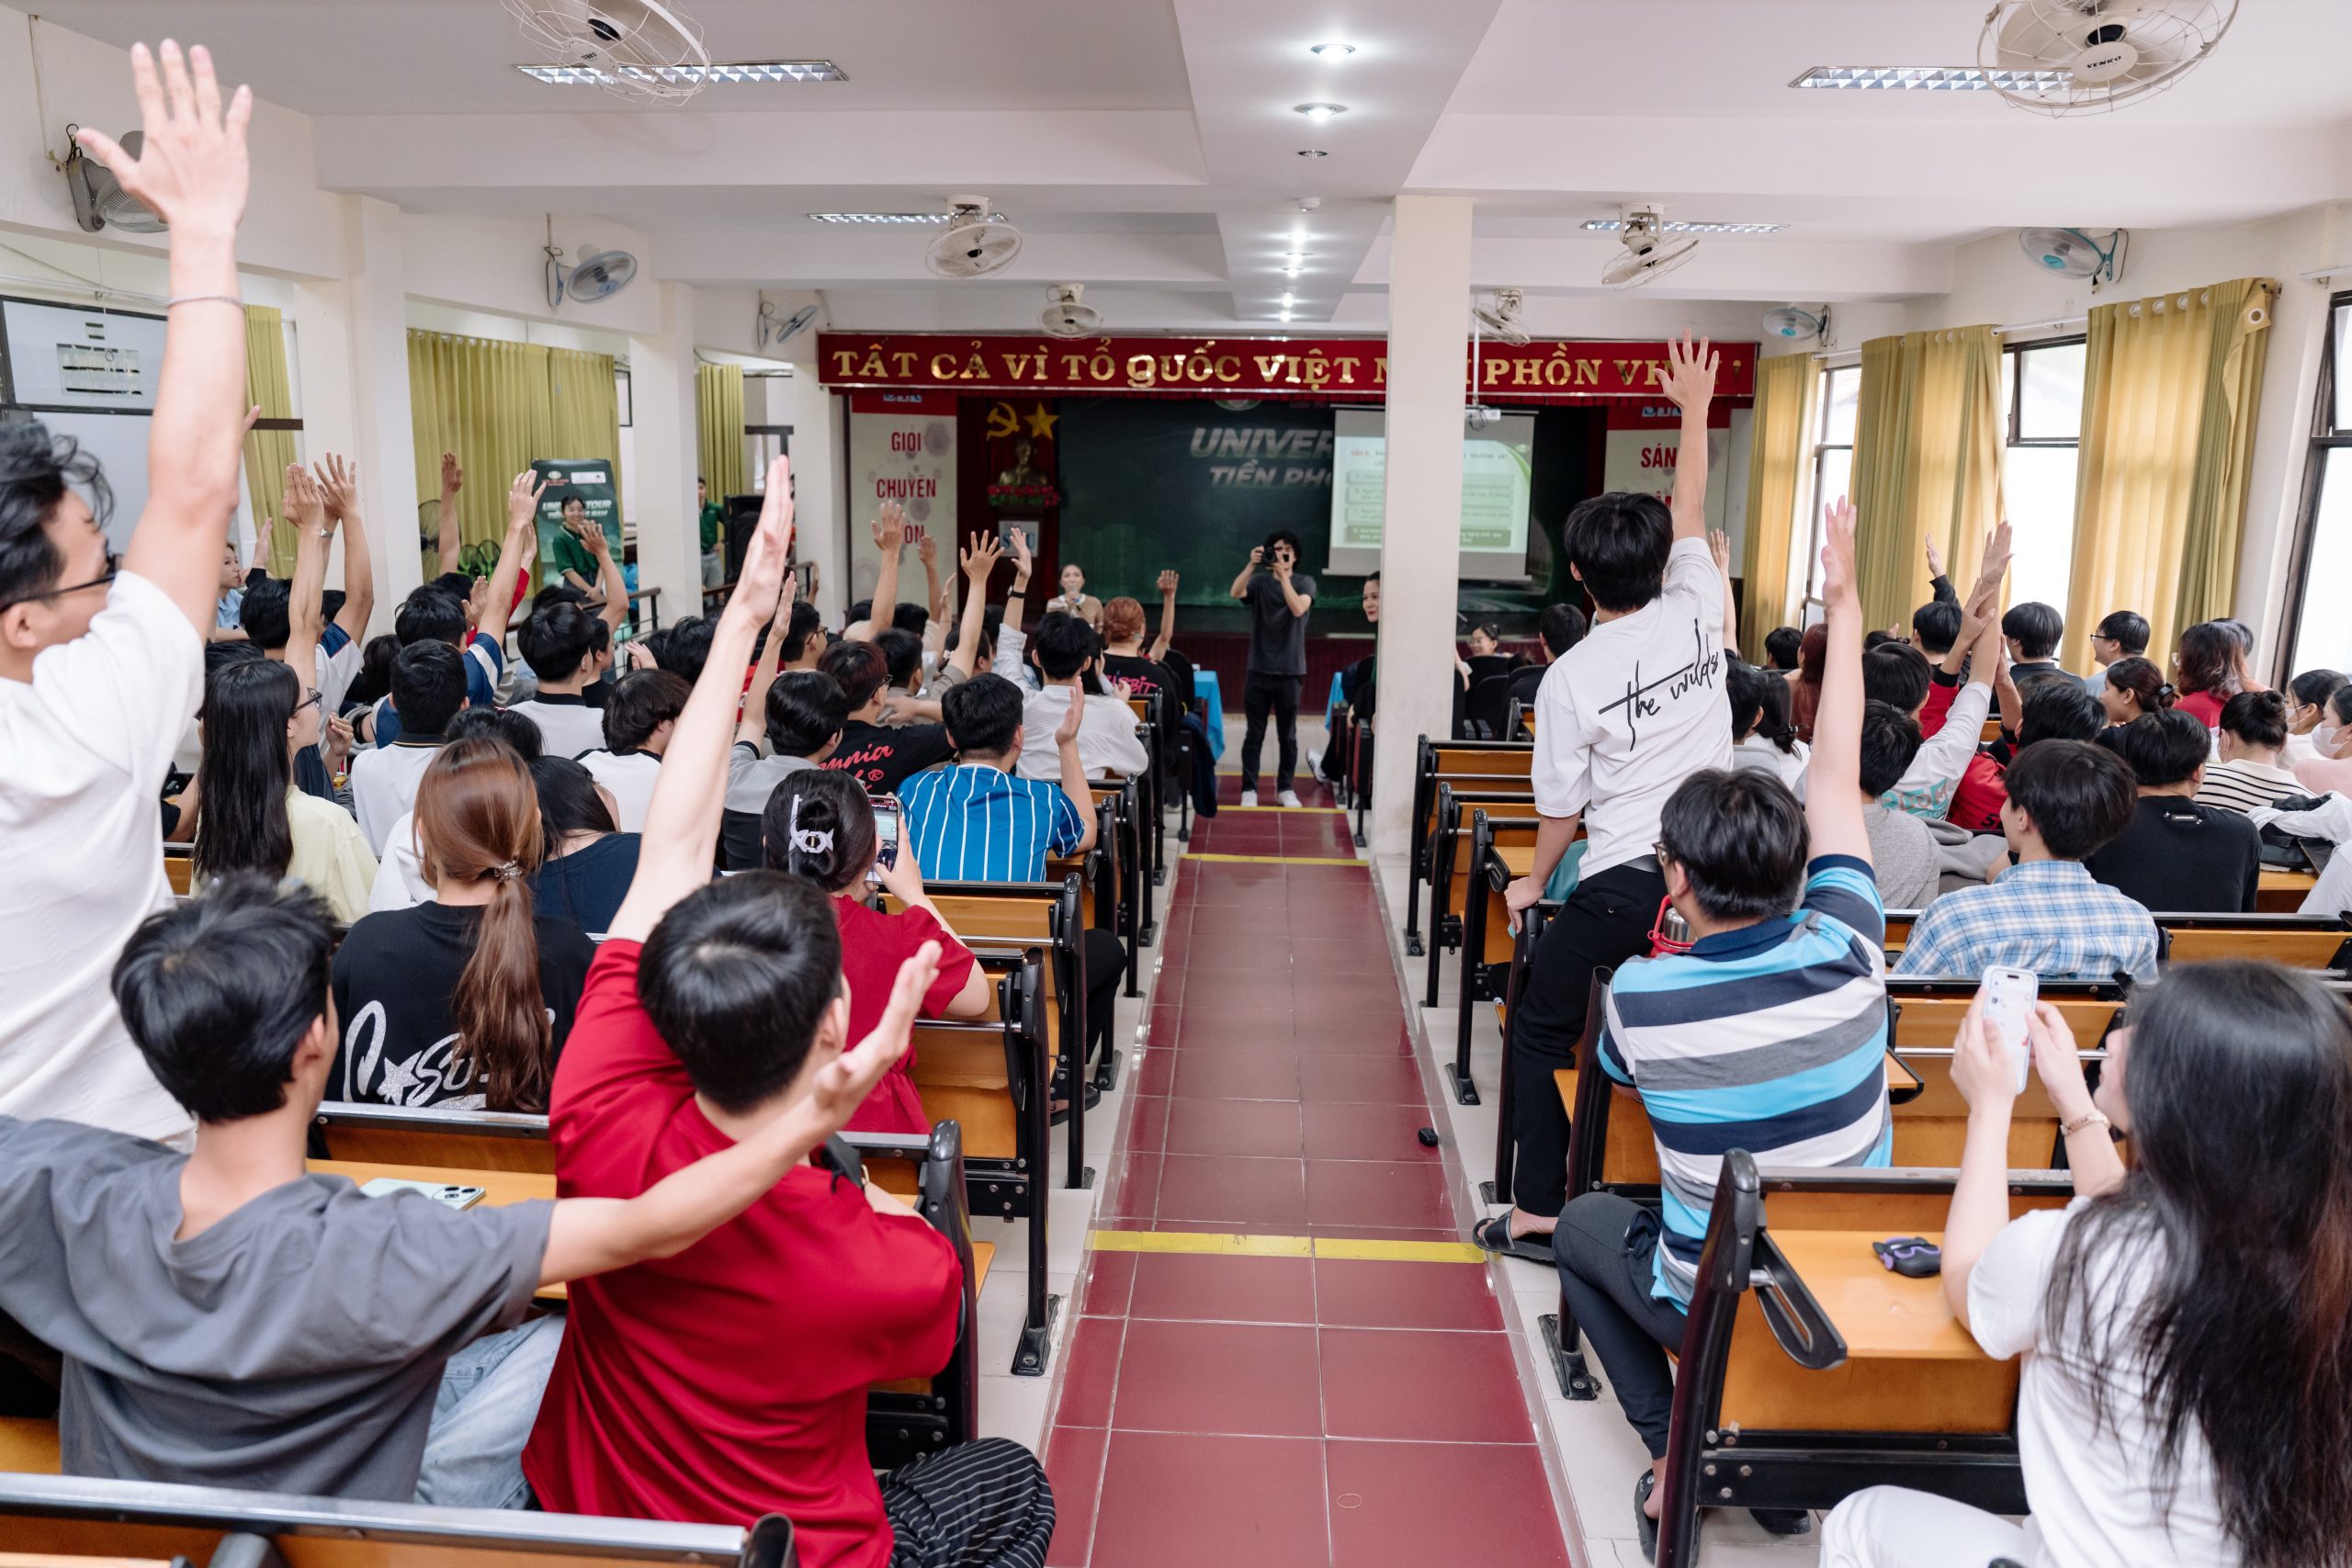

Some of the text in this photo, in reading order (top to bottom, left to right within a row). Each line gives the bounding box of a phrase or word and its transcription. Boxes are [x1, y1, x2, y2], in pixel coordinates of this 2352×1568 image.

[930, 340, 991, 380] CẢ
[1001, 344, 1049, 380] VÌ
[1060, 337, 1116, 382] TỔ
[1125, 340, 1241, 389] QUỐC
[1253, 347, 1361, 391] VIỆT
[1483, 342, 1603, 386] PHỒN
[1191, 427, 1333, 458] UNIVER
[1640, 443, 1678, 468] SÁN
[1002, 532, 1036, 549] SU
